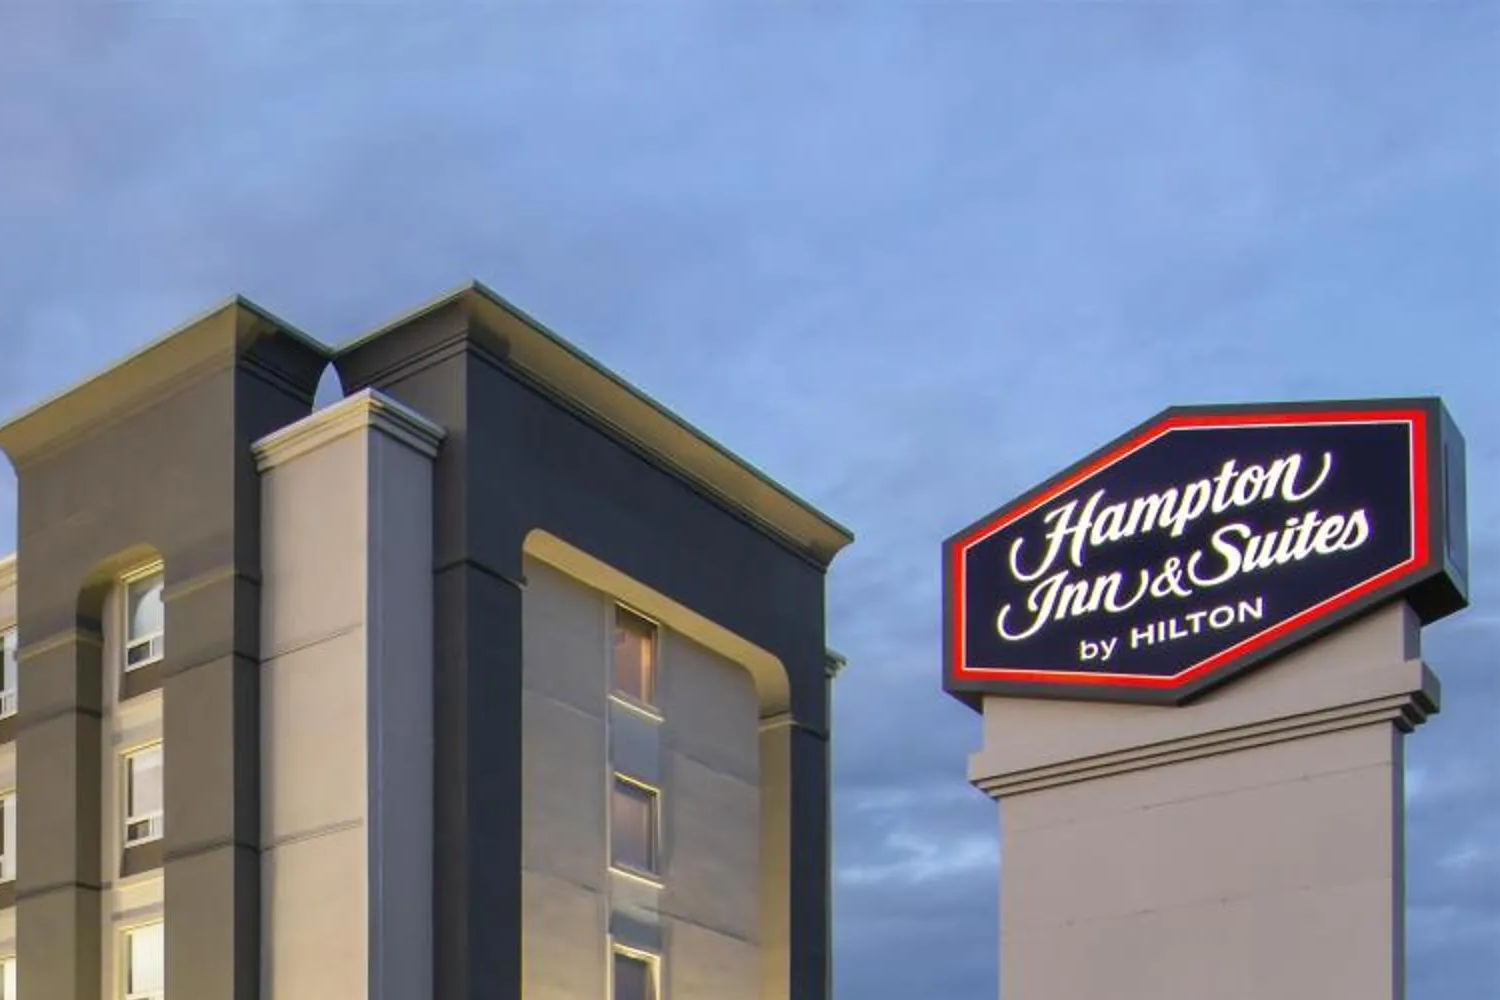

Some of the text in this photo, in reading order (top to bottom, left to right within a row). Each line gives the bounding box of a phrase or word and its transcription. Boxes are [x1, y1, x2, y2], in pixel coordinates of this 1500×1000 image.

[996, 507, 1370, 641] Inn & Suites
[1009, 451, 1332, 582] Hampton
[1079, 597, 1264, 661] by HILTON
